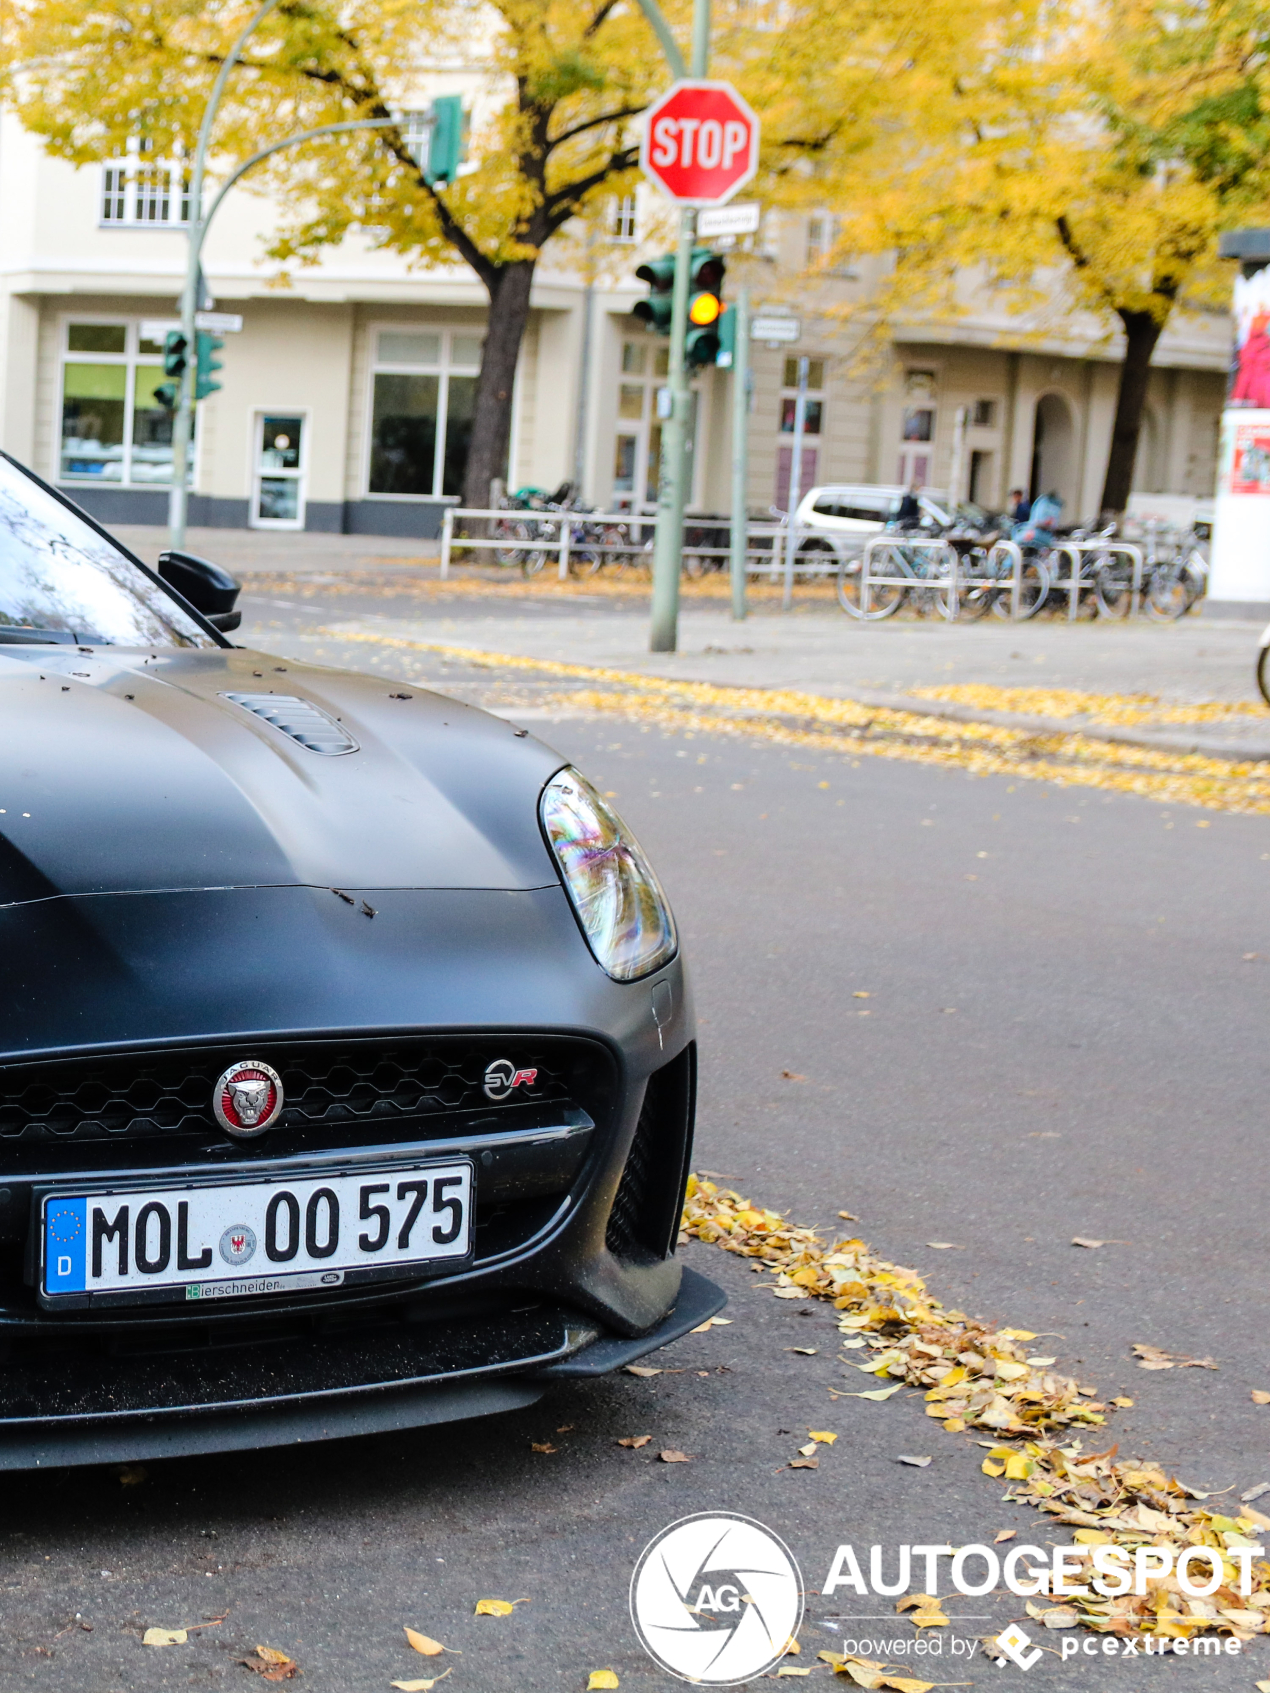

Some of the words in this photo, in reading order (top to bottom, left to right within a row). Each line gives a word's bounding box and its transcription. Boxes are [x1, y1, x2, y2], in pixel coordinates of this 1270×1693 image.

[652, 116, 748, 170] STOP
[223, 1061, 279, 1081] JAGUAR
[483, 1065, 538, 1090] SVR
[57, 1256, 72, 1276] D
[92, 1201, 213, 1277] MOL
[358, 1176, 463, 1252] 575
